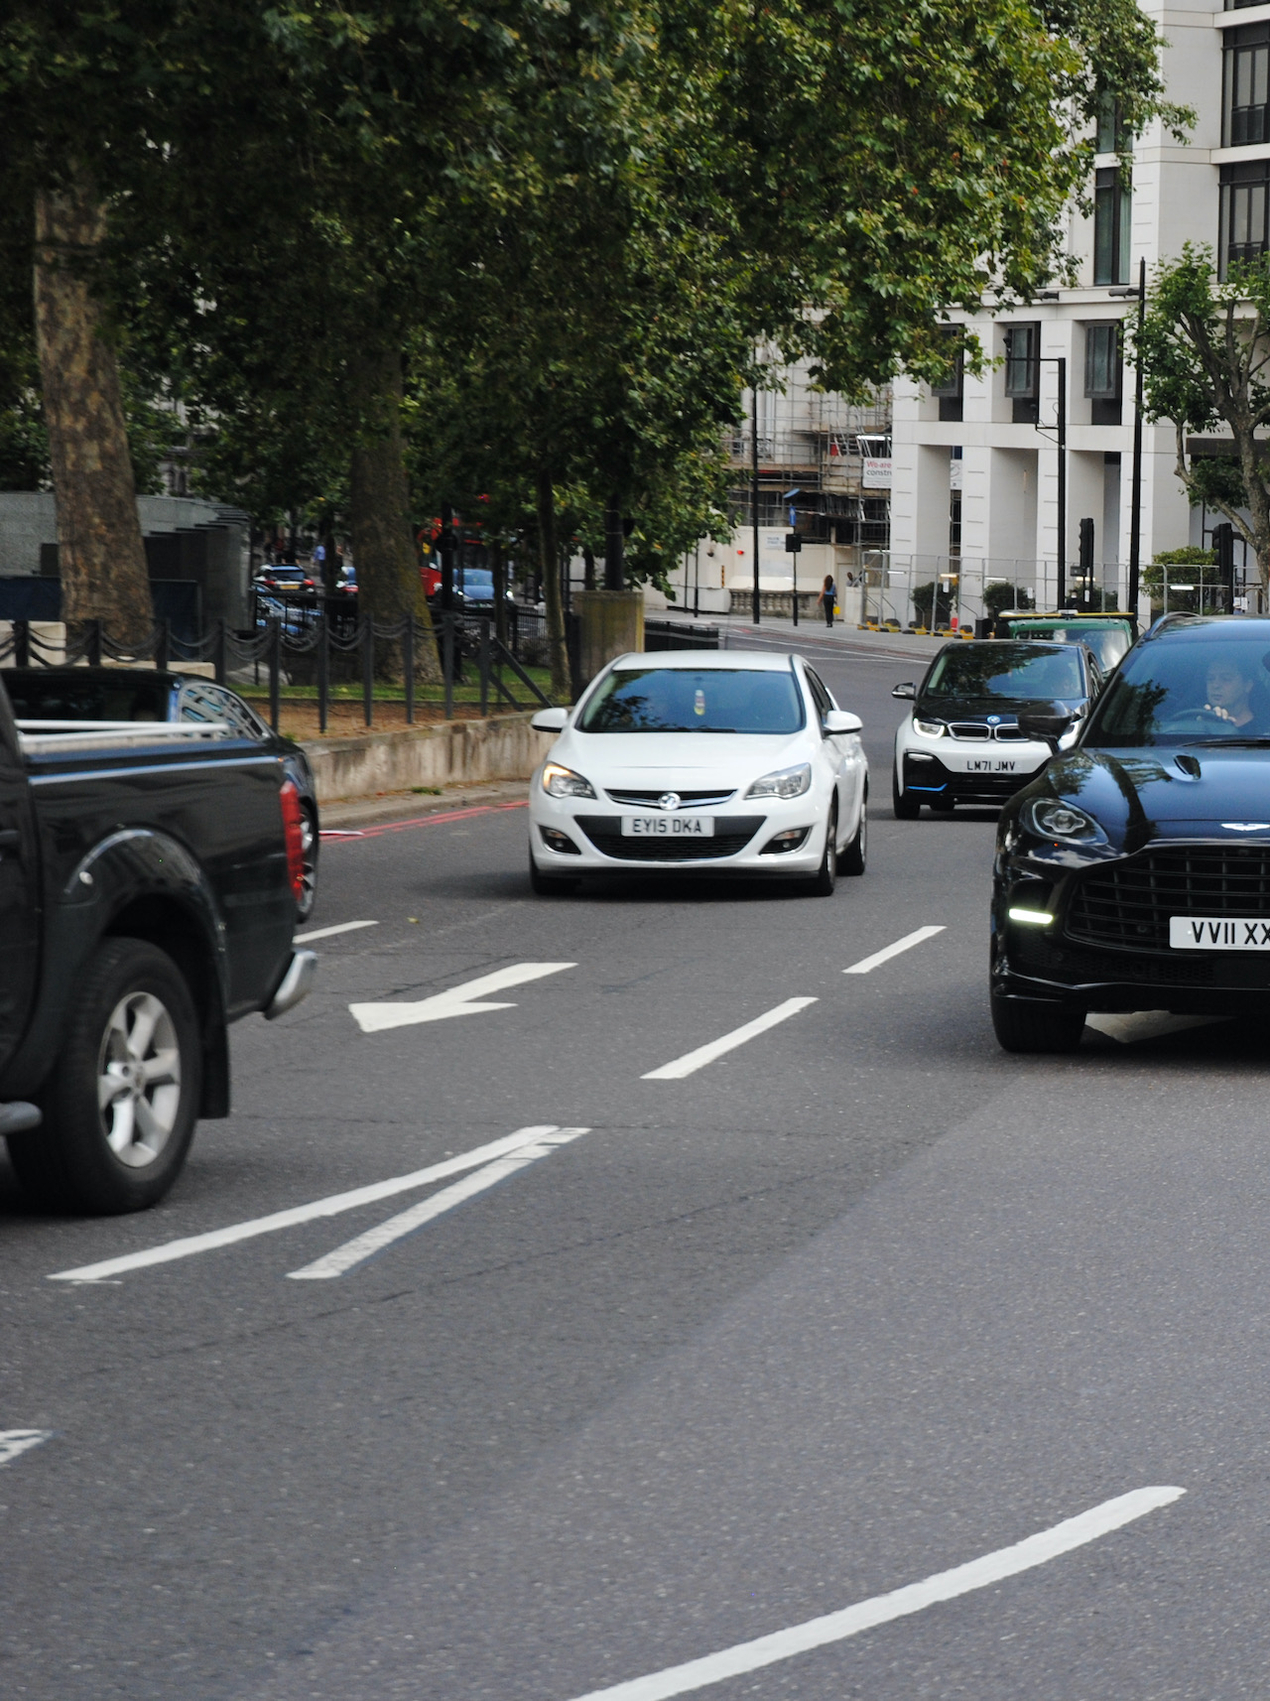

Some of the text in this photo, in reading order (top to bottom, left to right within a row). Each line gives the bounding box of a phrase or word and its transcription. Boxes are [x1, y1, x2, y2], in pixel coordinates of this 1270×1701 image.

[967, 761, 1015, 771] LM71 JMV
[633, 819, 702, 833] EY15 DKA
